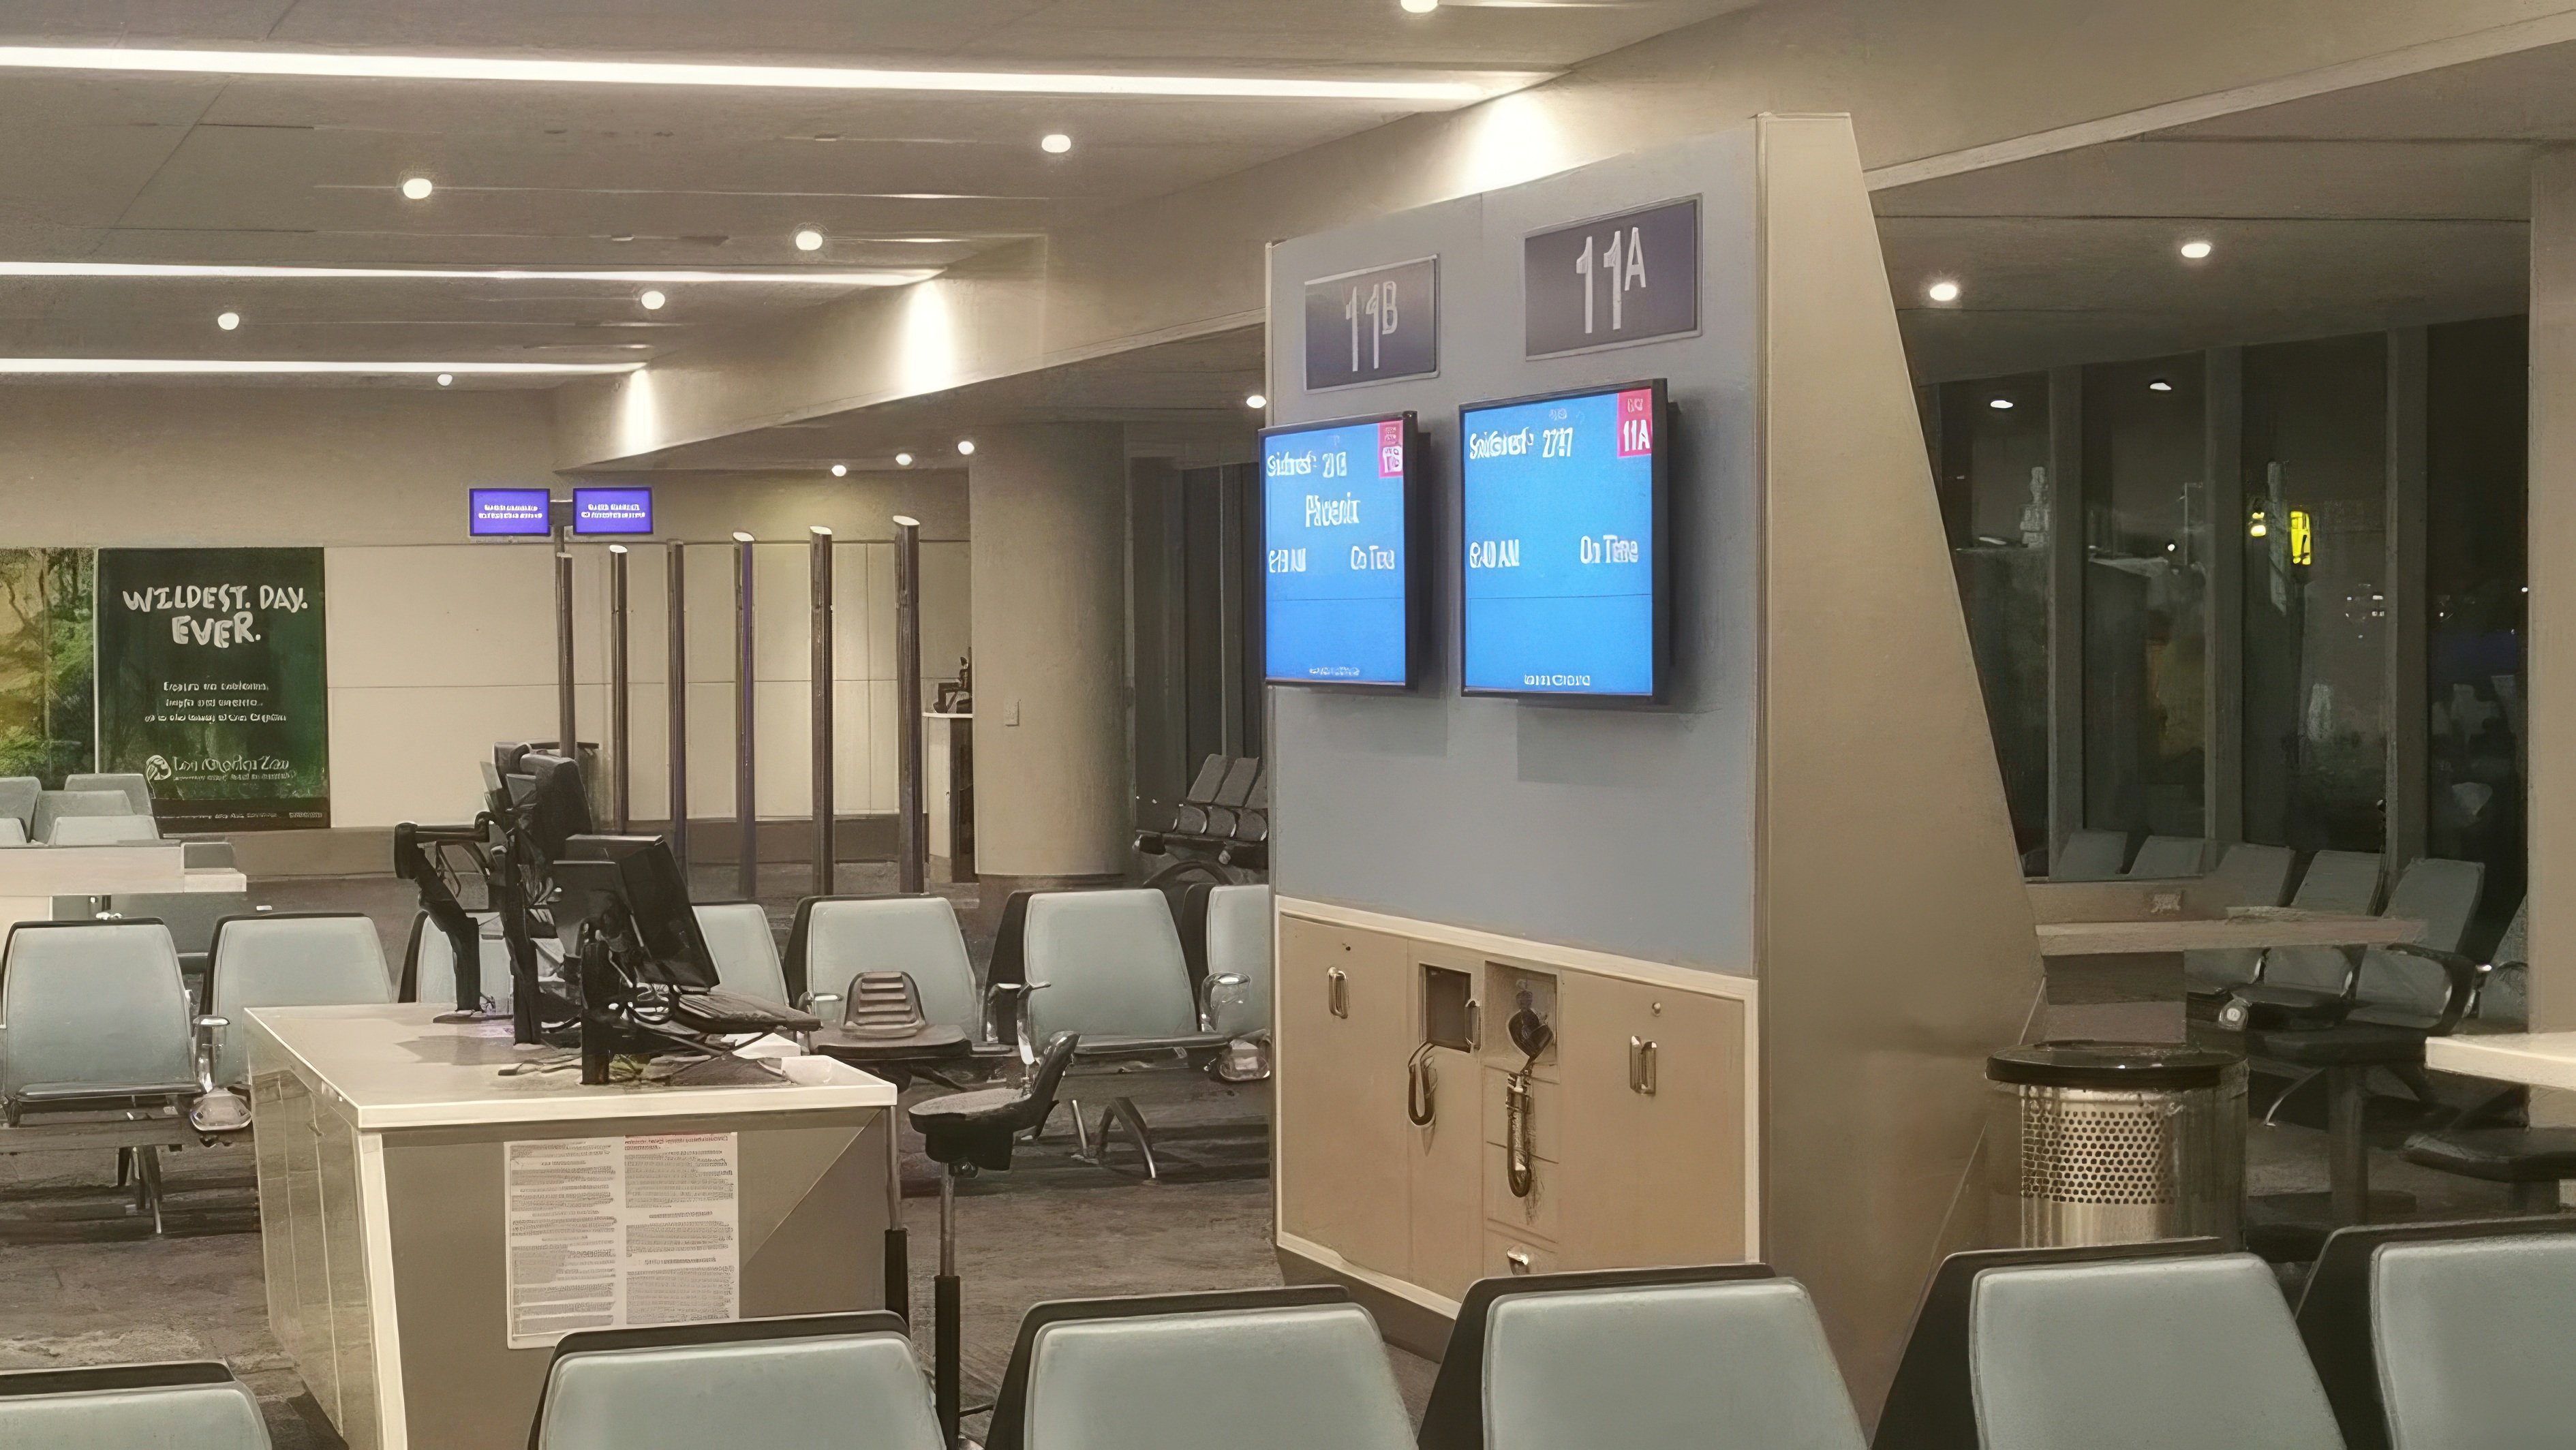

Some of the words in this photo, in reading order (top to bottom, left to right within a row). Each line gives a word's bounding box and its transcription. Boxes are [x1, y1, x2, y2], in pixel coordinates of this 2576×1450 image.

[1576, 227, 1646, 333] 11A
[1345, 281, 1398, 371] 11B
[1623, 419, 1650, 452] 11A
[123, 584, 251, 612] WILDEST.
[260, 585, 308, 613] DAY.
[172, 611, 261, 648] EVER.
